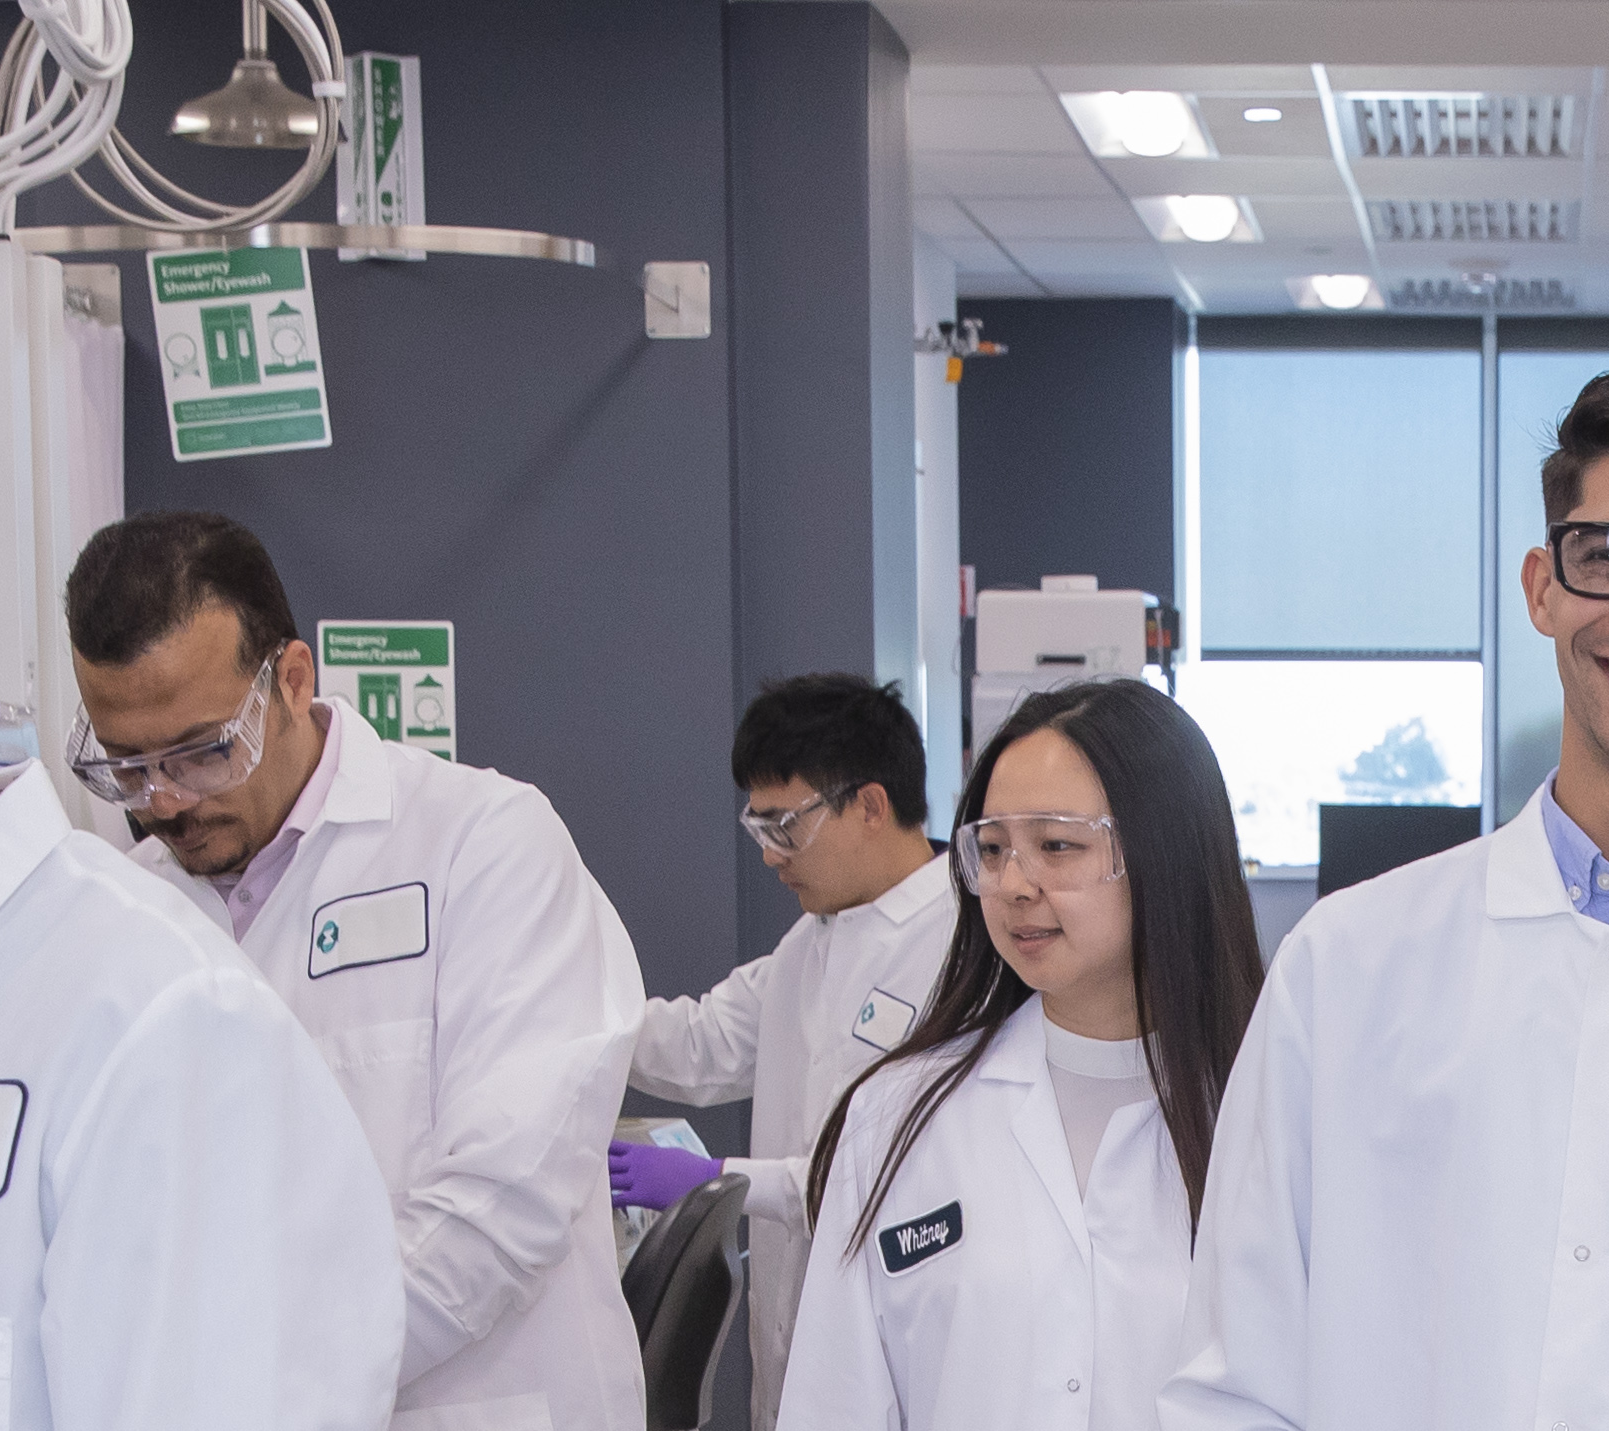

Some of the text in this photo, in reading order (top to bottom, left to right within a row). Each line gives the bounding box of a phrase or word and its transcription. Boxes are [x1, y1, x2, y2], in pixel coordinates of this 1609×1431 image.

[160, 261, 231, 279] Emergency
[163, 272, 272, 296] Shower/Eyewash
[328, 634, 388, 649] Emergency
[329, 648, 421, 662] Shower/Eyewash
[896, 1219, 949, 1256] Whitney
